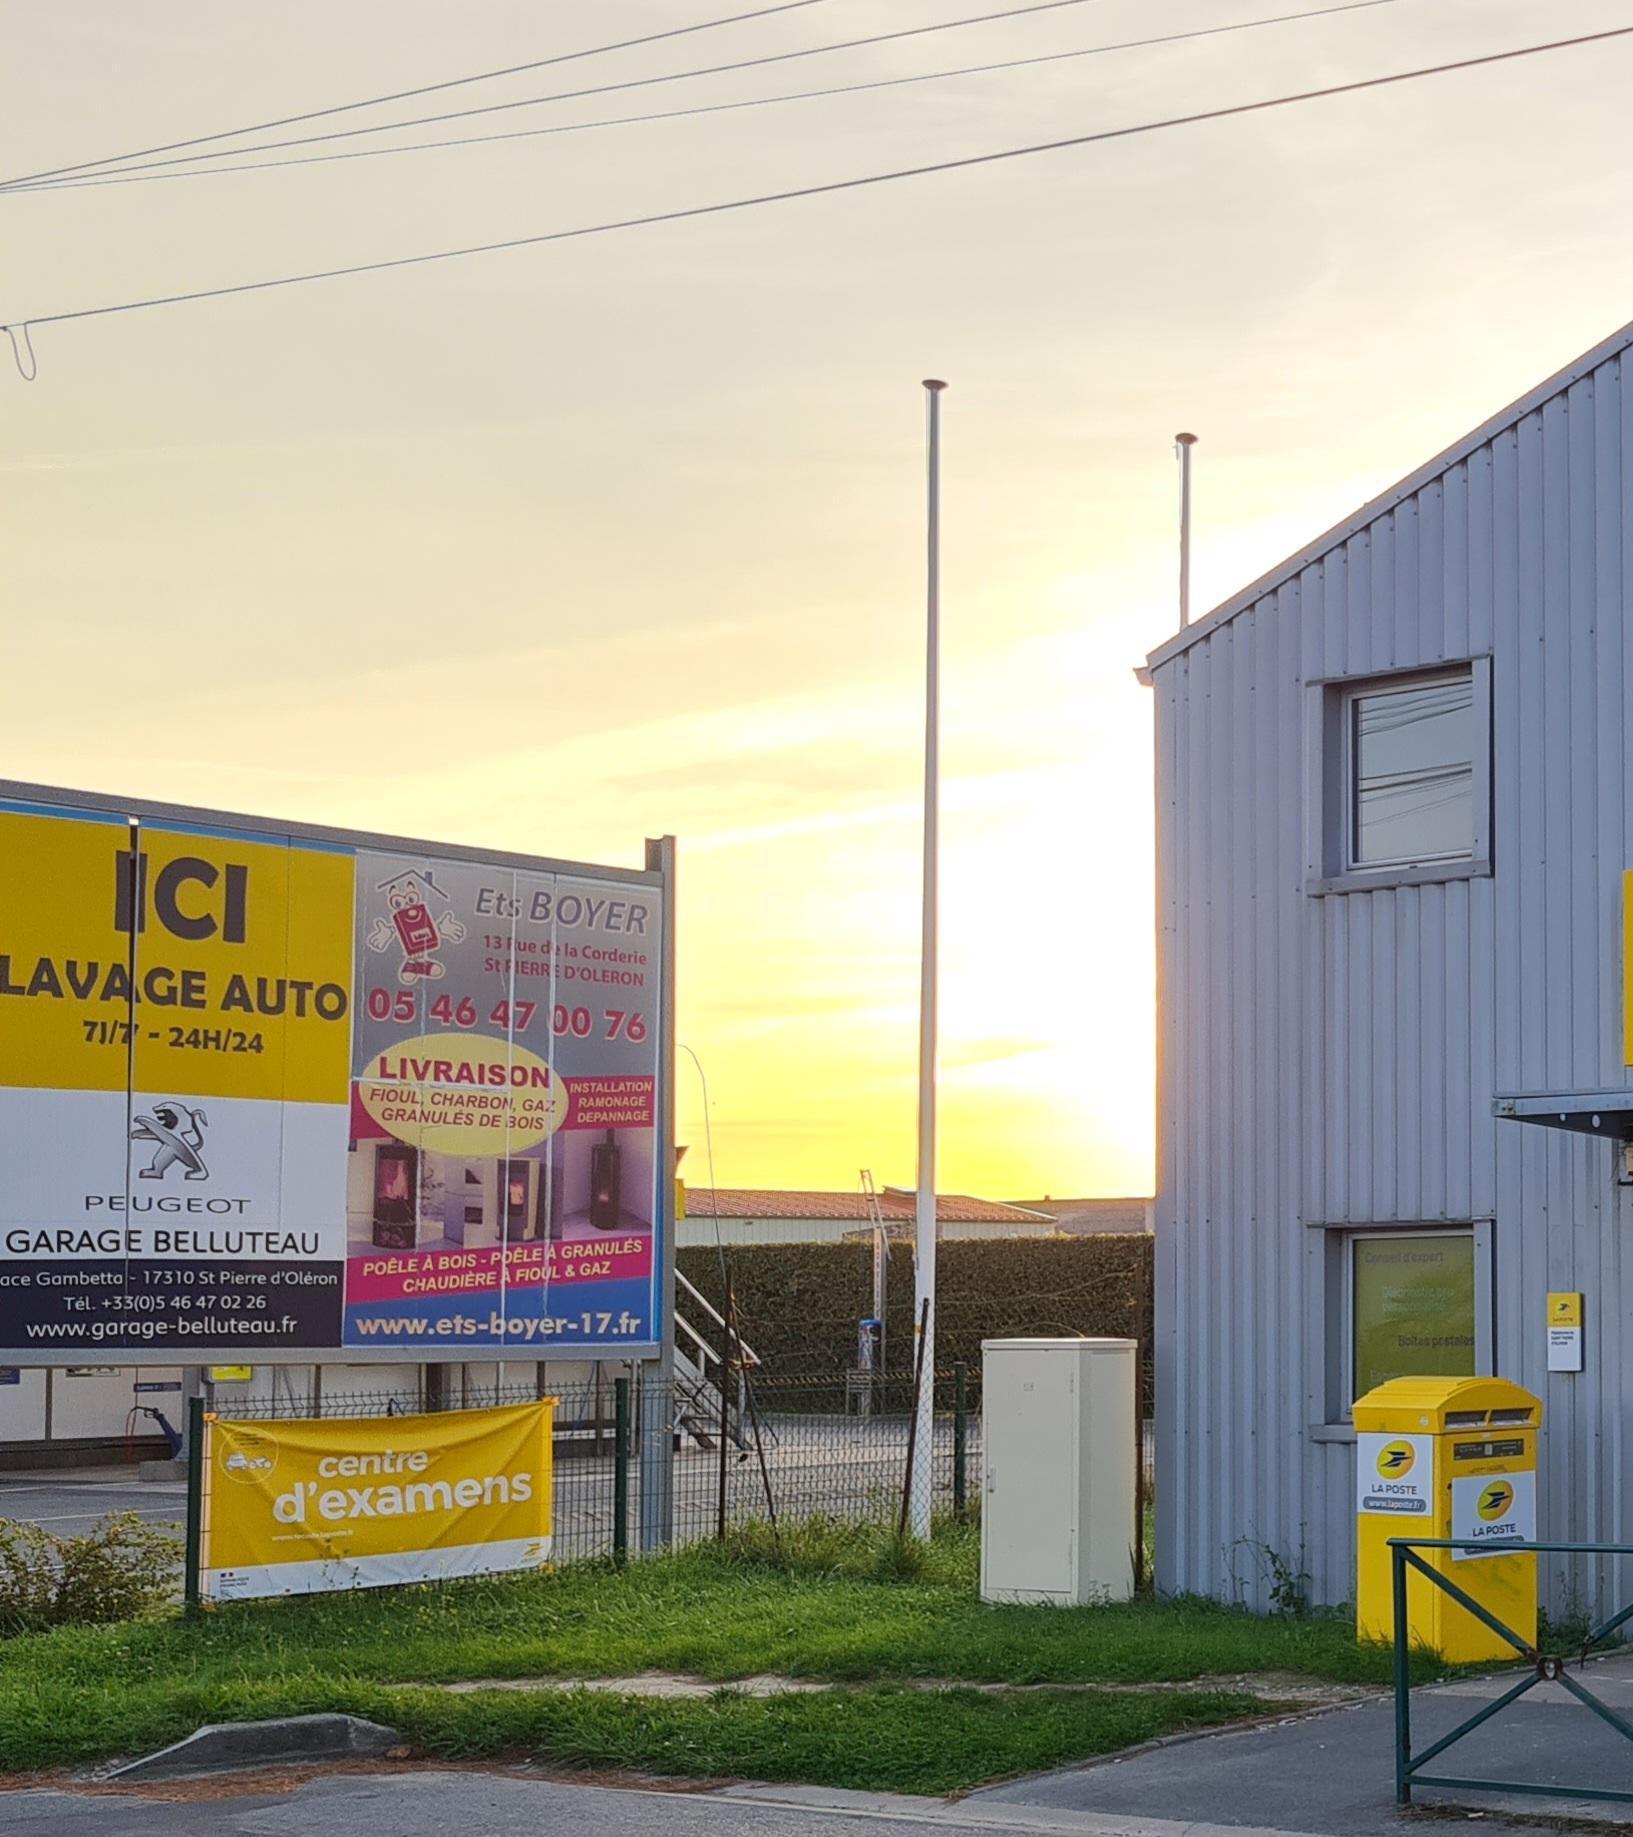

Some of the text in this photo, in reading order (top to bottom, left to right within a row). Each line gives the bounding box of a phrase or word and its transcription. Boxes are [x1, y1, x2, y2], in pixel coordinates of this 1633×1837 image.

[115, 850, 248, 943] ICI
[476, 888, 648, 934] Ets BOYER
[484, 935, 502, 949] 13
[507, 936, 537, 953] Rue
[565, 942, 578, 958] la
[582, 945, 648, 966] Corderie
[484, 957, 645, 986] St PIERRE D'OLERON
[0, 954, 348, 1021] LAVAGE AUTO
[367, 987, 647, 1043] 05 46 47 00 76
[168, 1026, 265, 1054] 24H/24
[379, 1056, 551, 1089] LIVRAISON
[370, 1088, 556, 1113] FIOUL, CHARBON, GAZ
[569, 1081, 653, 1094] INSTALLATION
[577, 1096, 647, 1109] RAMONAGE
[381, 1107, 545, 1130] GRANULÉS DE BOIS
[84, 1195, 251, 1214] PEUGEOT
[5, 1230, 319, 1254] GARAGE BELLUTEAU
[362, 1257, 418, 1276] POÊLE
[422, 1253, 434, 1271] À
[438, 1254, 477, 1271] BOIS
[490, 1246, 543, 1266] POÊLE
[561, 1238, 643, 1258] GRANULÉS
[0, 1275, 31, 1286] ace
[36, 1270, 124, 1286] Gambetta
[144, 1270, 195, 1286] 17310
[199, 1271, 215, 1286] St
[220, 1270, 266, 1285] Pierre
[270, 1270, 338, 1286] d'Oléron
[403, 1270, 497, 1293] CHAUDIÈRE
[515, 1266, 561, 1283] FIOUL
[565, 1264, 576, 1278] &
[579, 1261, 612, 1277] GAZ
[64, 1294, 267, 1313] Tél. +33(0)5 46 47 02 26
[26, 1315, 298, 1341] www.garage-belluteau.fr
[355, 1311, 641, 1340] www.ets-boyer-17.fr
[318, 1449, 429, 1478] centre
[271, 1471, 533, 1524] d'examens
[1371, 1484, 1417, 1495] LA POSTE
[1472, 1523, 1516, 1537] LA POSTE
